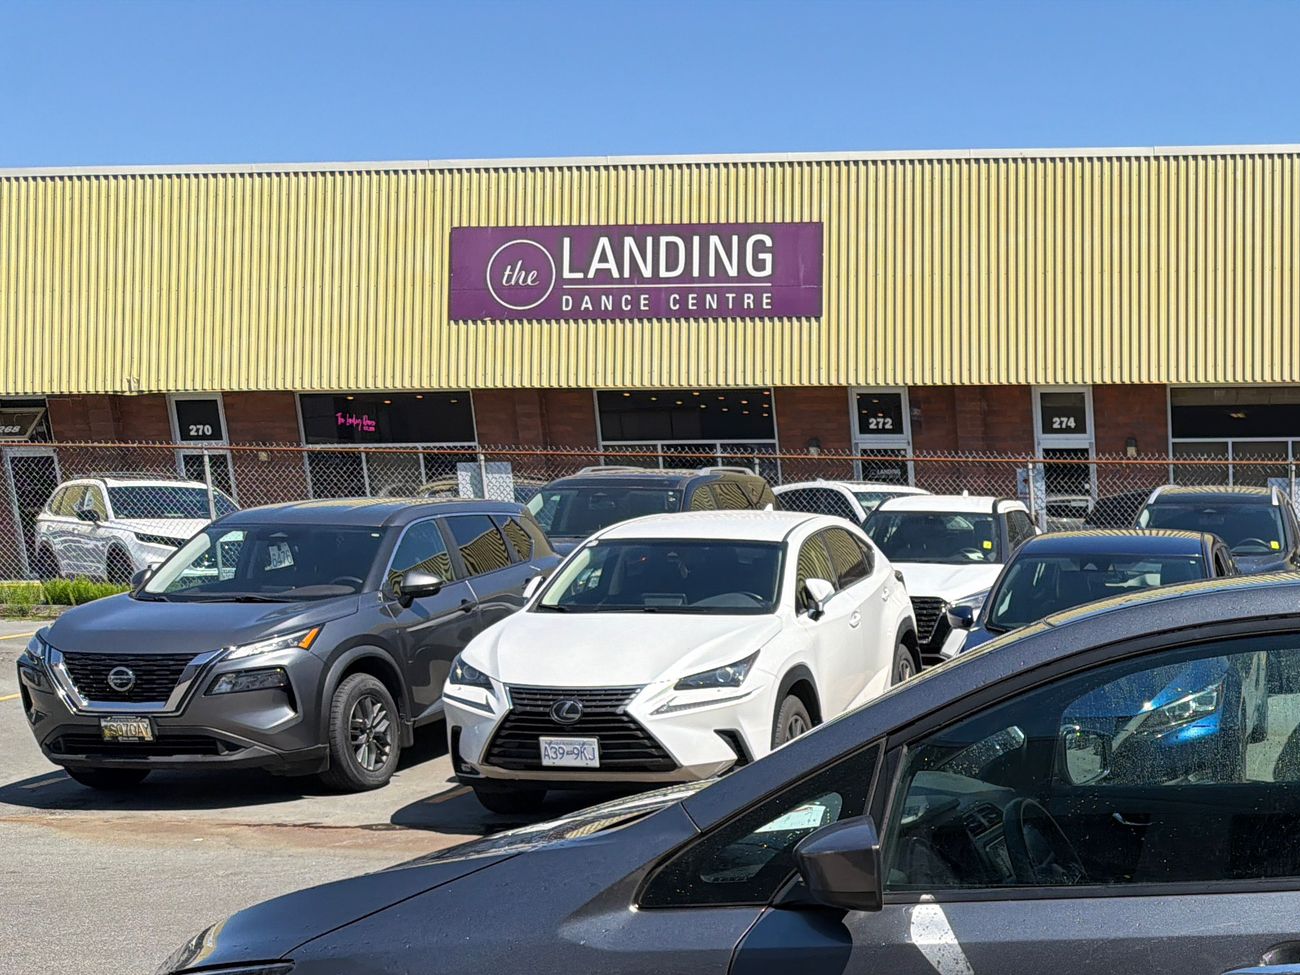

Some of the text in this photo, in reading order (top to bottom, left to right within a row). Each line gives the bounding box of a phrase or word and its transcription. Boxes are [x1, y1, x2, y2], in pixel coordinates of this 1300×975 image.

[502, 234, 773, 287] the LANDING
[562, 292, 772, 311] DANCE CENTRE
[868, 417, 893, 430] 272
[1052, 417, 1076, 429] 274
[189, 425, 213, 436] 270
